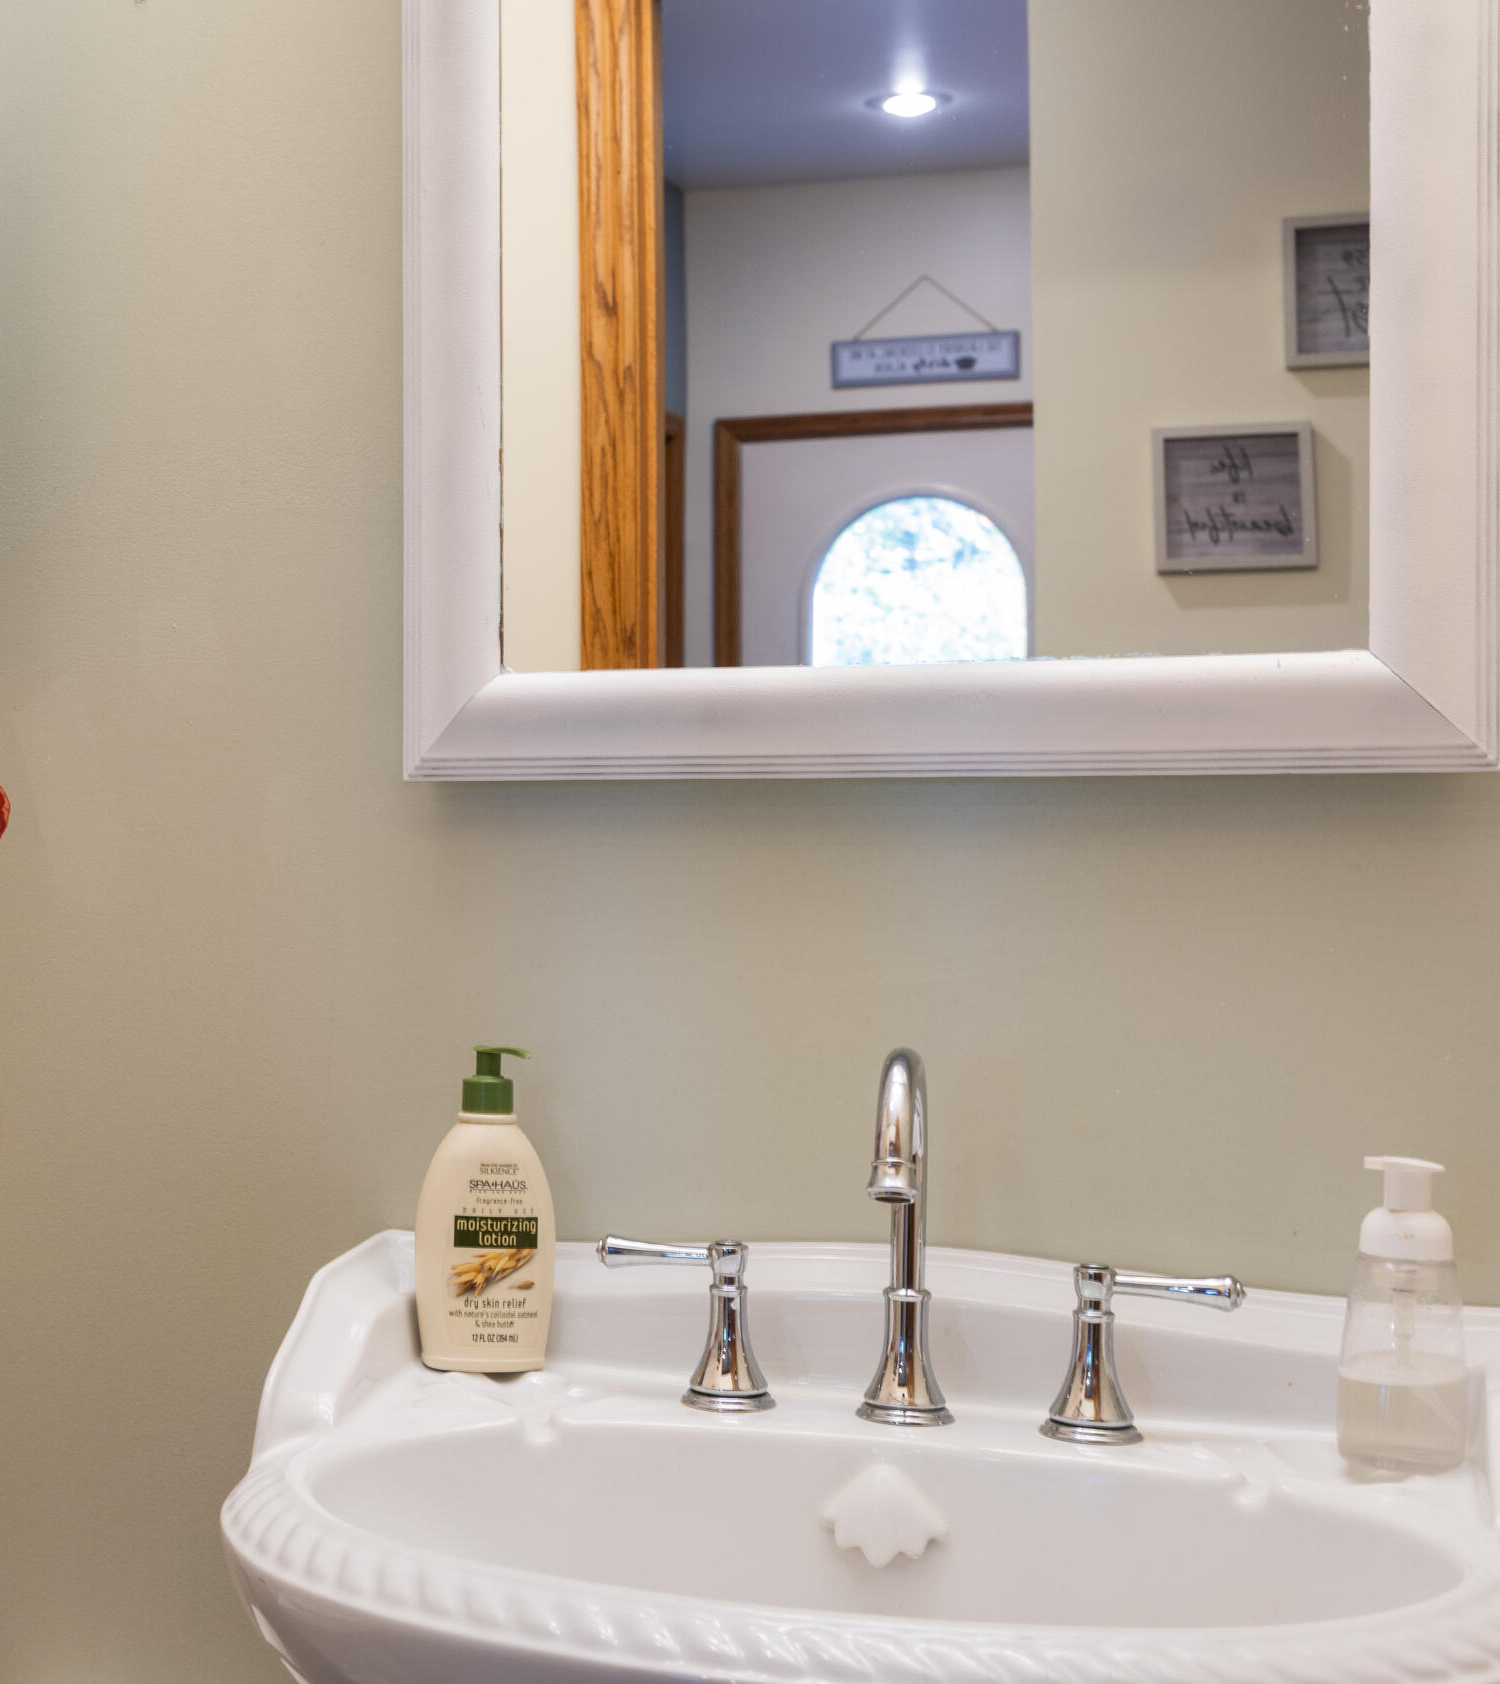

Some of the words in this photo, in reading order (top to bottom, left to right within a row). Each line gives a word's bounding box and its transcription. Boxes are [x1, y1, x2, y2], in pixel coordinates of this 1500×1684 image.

[456, 1217, 537, 1235] moisturizing
[478, 1231, 517, 1246] lotion
[464, 1297, 479, 1309] dry
[482, 1298, 500, 1308] skin
[502, 1298, 527, 1309] relief
